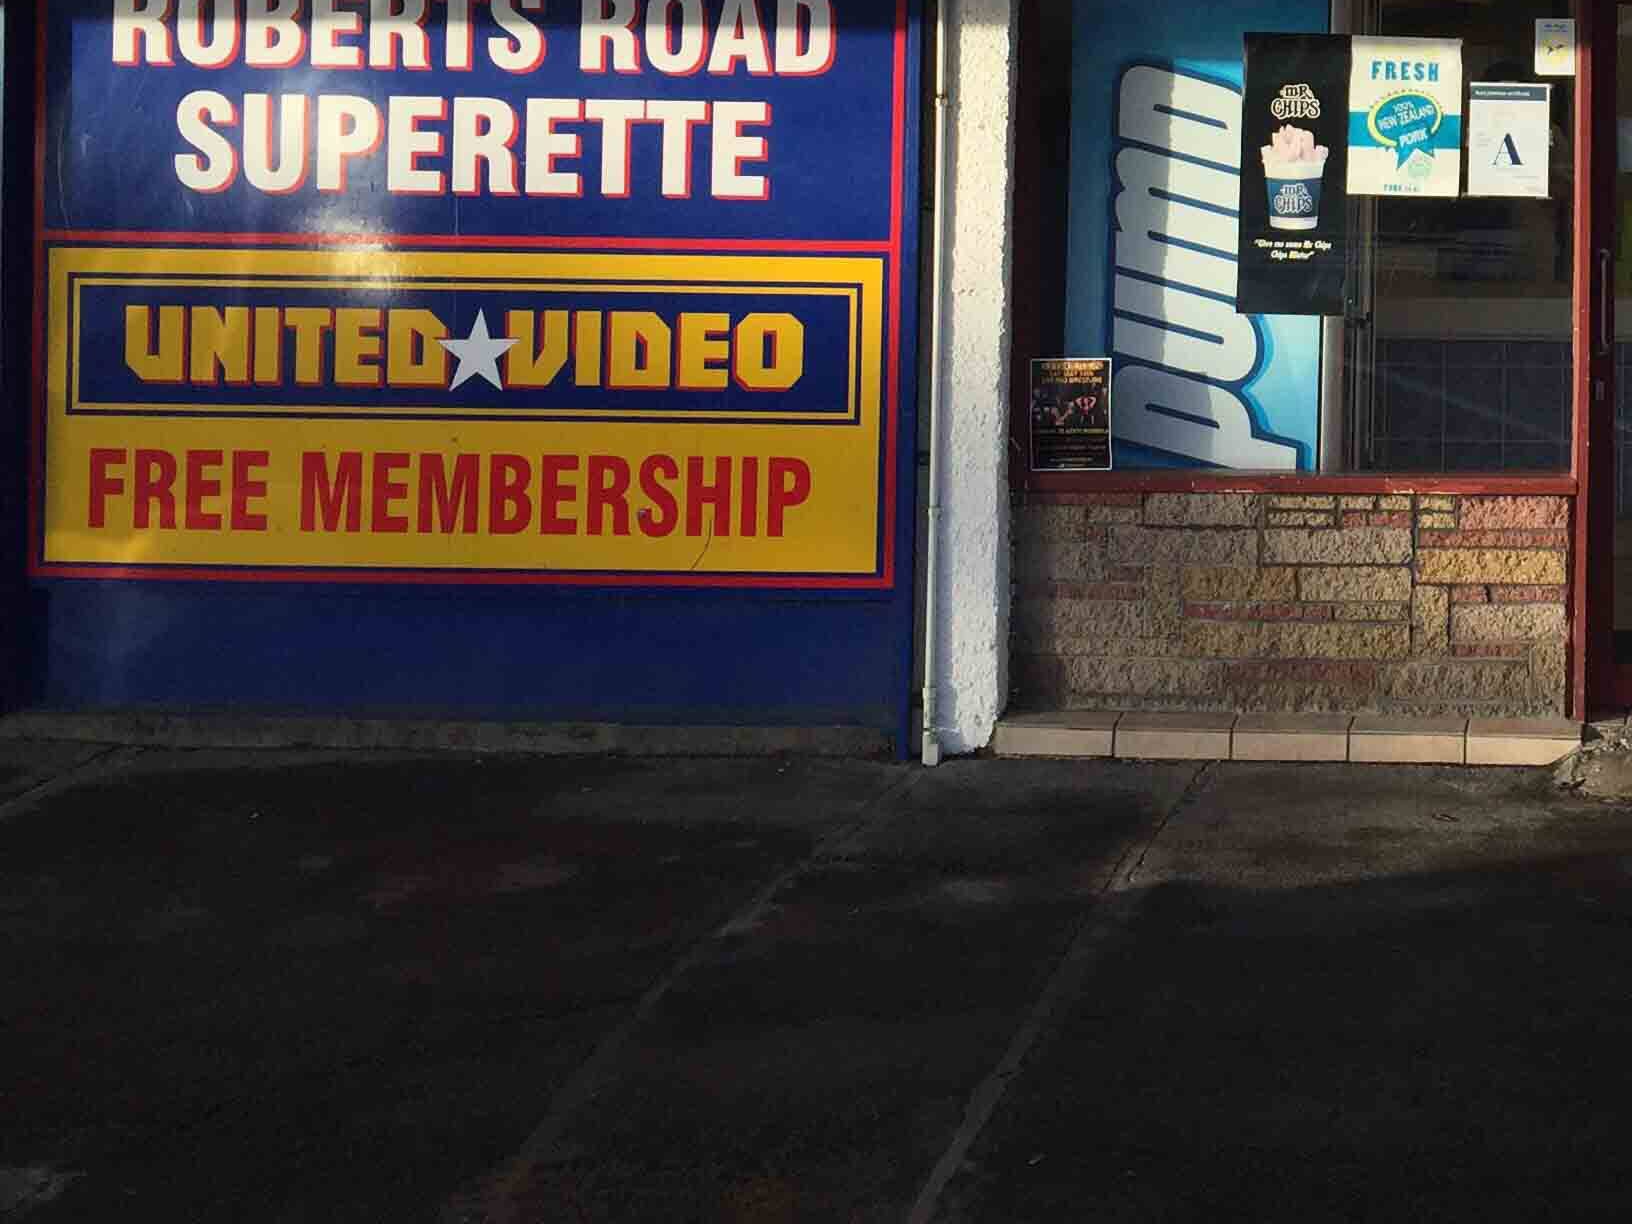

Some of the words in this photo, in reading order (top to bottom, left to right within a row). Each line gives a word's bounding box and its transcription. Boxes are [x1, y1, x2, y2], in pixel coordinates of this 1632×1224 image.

[1371, 60, 1440, 82] FRESH
[1270, 97, 1321, 120] CHIPS
[174, 89, 773, 201] SUPERETTE
[1491, 133, 1524, 166] A
[125, 304, 450, 389] UNITED
[504, 308, 805, 393] VIDEO
[87, 447, 271, 533] FREE
[299, 450, 813, 539] MEMBERSHIP
